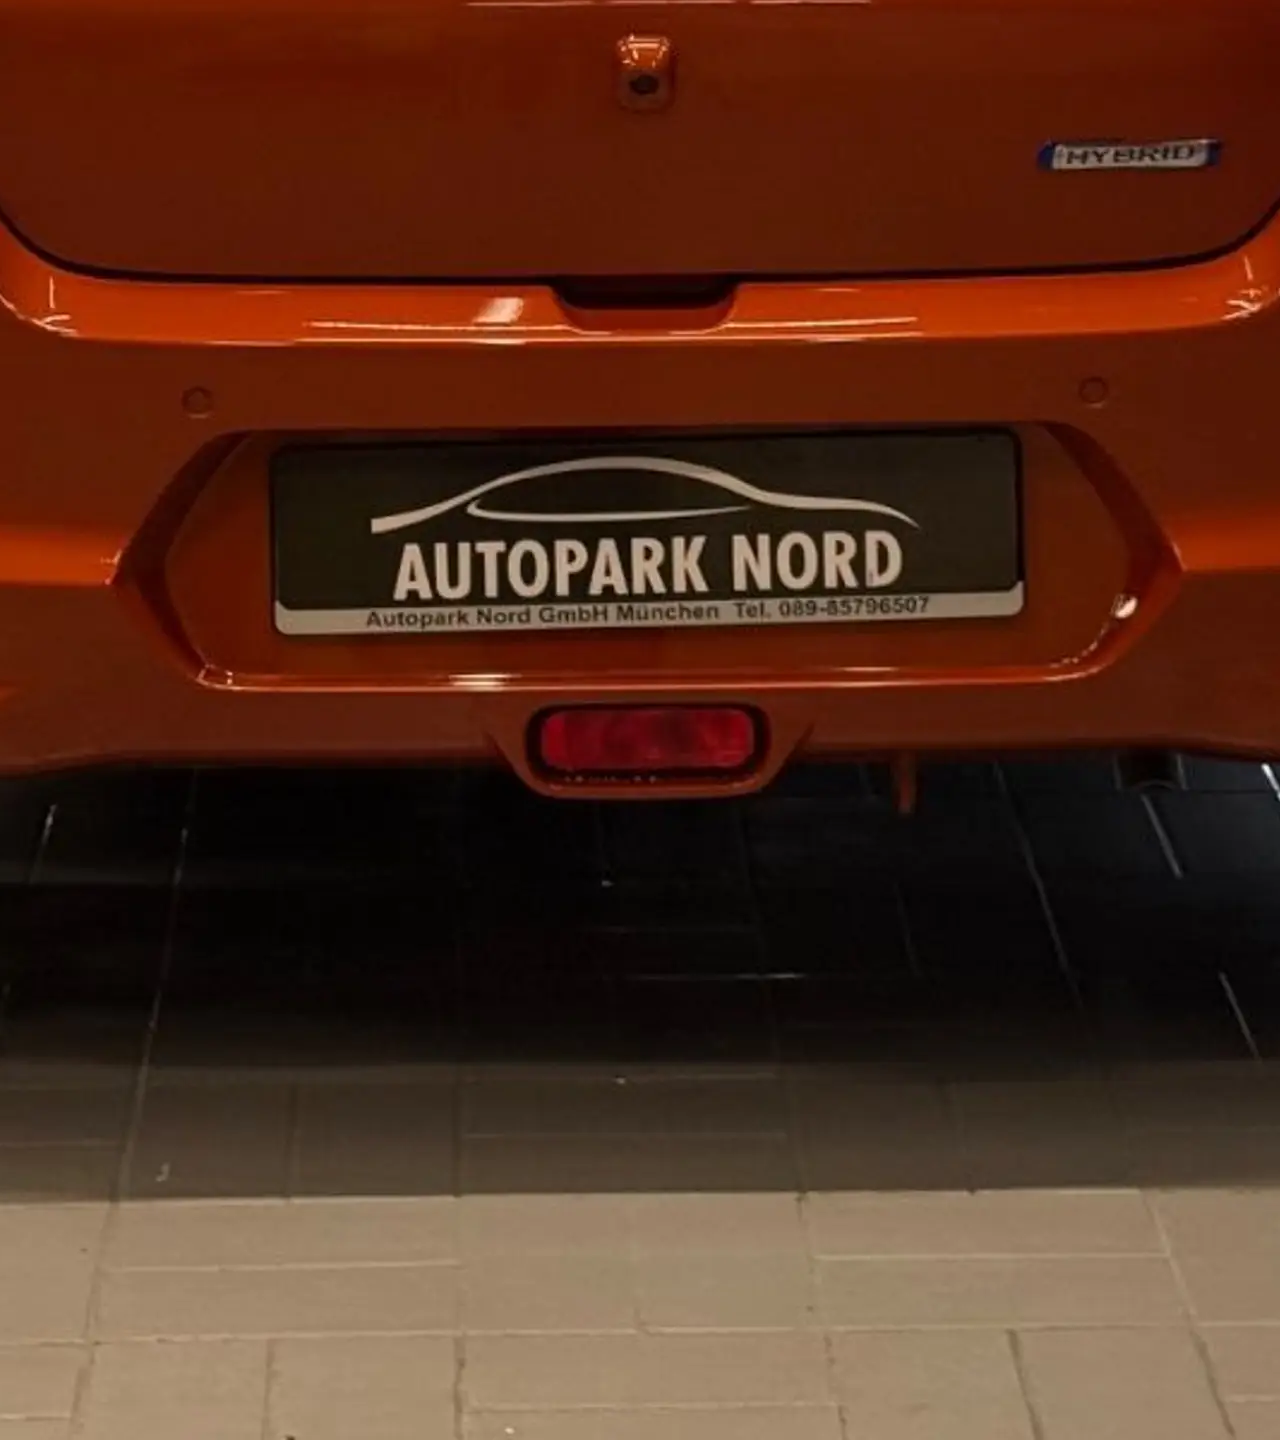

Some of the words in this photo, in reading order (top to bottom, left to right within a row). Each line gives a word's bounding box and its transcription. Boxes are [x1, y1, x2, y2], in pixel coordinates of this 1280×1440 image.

[1065, 145, 1195, 165] HYBRID
[392, 535, 709, 602] AUTOPARK
[731, 530, 903, 593] NORD
[366, 609, 470, 631] Autopark
[476, 606, 532, 625] Nord
[538, 605, 608, 623] GmbH
[616, 602, 719, 622] München
[736, 601, 771, 619] Tel.
